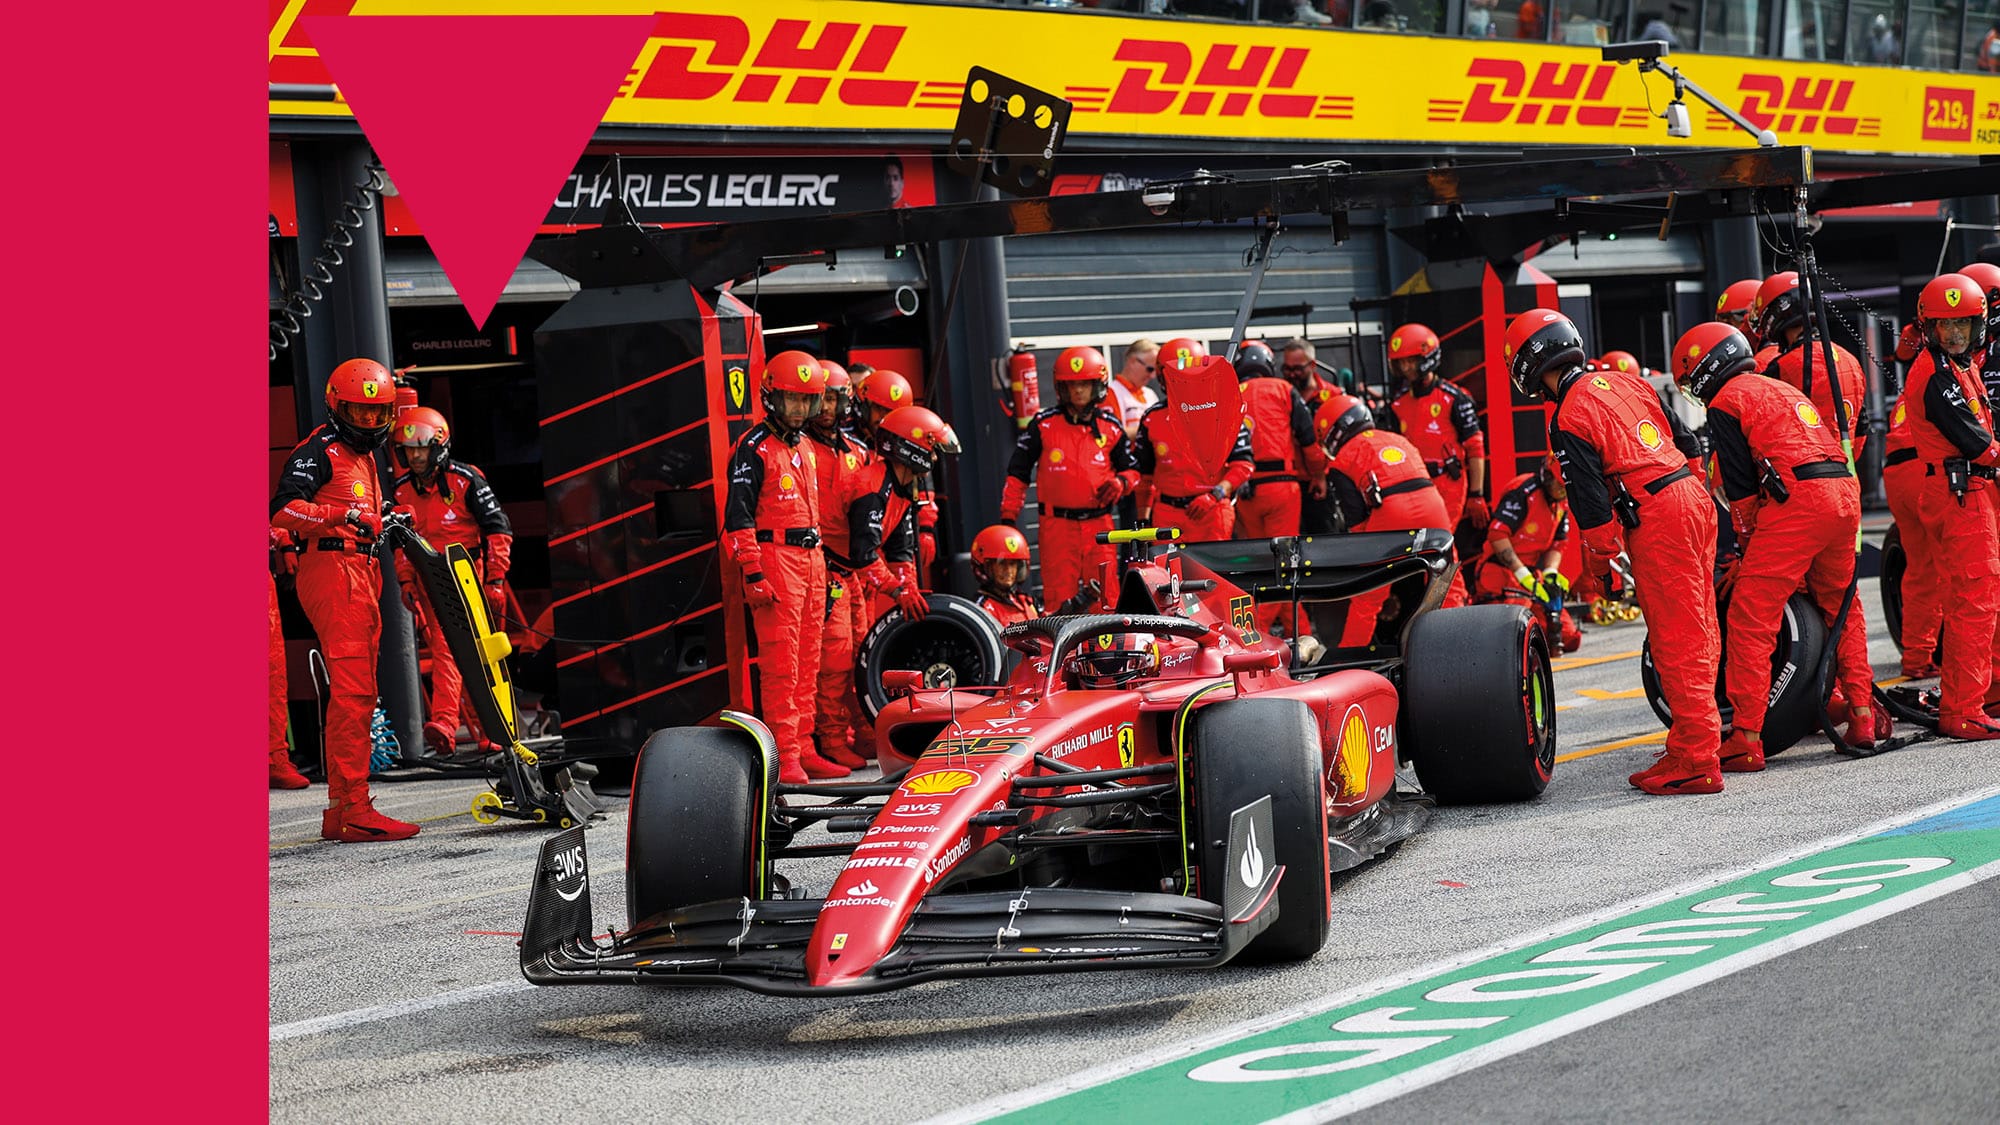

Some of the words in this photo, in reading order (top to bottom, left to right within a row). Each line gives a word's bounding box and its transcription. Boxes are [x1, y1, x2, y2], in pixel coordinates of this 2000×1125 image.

[633, 11, 919, 107] DHL
[1106, 39, 1317, 118] DHL
[1462, 58, 1621, 127] DHL
[1735, 74, 1859, 136] DHL
[707, 174, 839, 208] LECLERC
[1188, 401, 1217, 411] brembo
[866, 609, 904, 649] ZER
[1134, 616, 1182, 629] Snapdragon
[1230, 594, 1262, 646] 55
[1162, 652, 1193, 667] Ray-Ban
[920, 736, 1035, 758] 55
[953, 727, 1032, 736] VELAS
[1051, 733, 1088, 760] RICHARD
[1090, 724, 1114, 744] MILLE
[895, 803, 943, 812] aws
[882, 825, 941, 834] Palantir
[843, 857, 920, 871] MAHLE
[932, 834, 972, 878] Santander
[1186, 855, 1954, 1083] aramco
